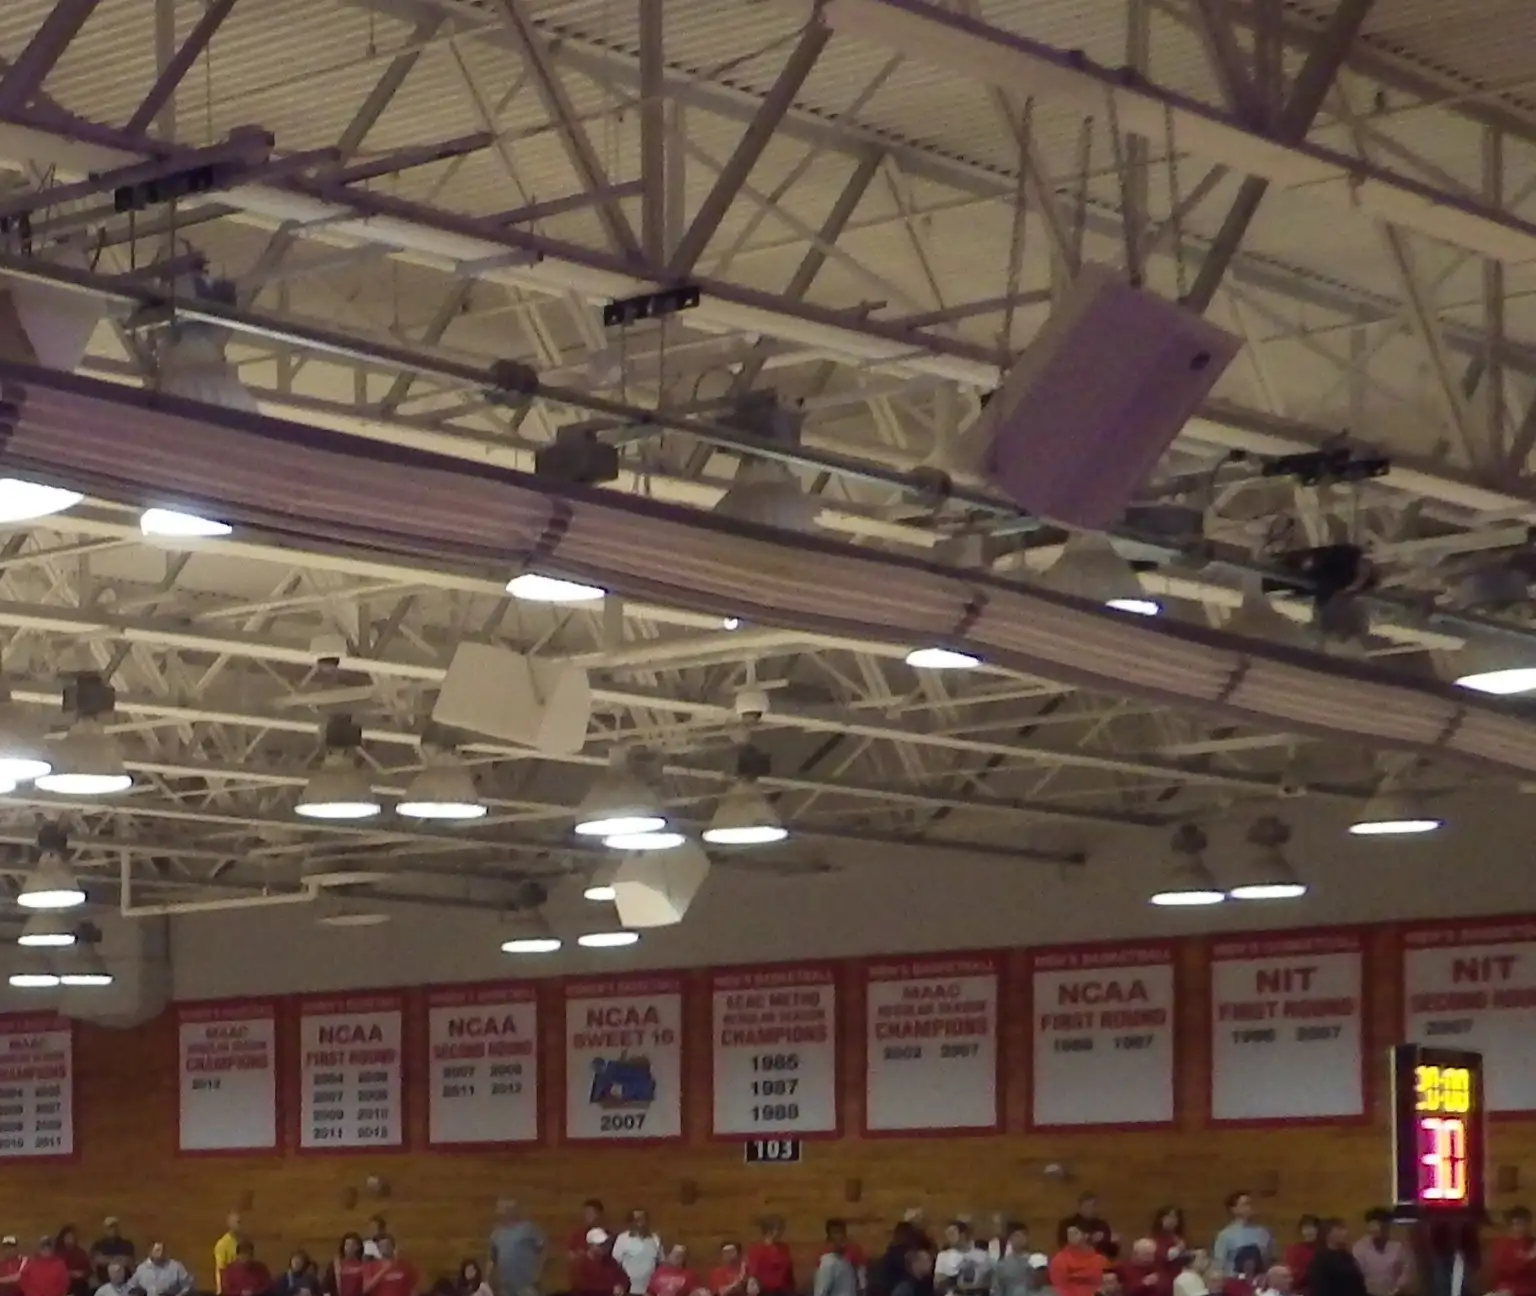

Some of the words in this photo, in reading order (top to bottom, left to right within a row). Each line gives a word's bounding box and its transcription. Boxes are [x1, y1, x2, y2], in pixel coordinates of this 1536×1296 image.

[1451, 955, 1520, 984] NIT
[1256, 966, 1318, 994] NIT
[903, 984, 961, 999] MAAC
[1058, 980, 1149, 1005] NCAA
[448, 1015, 516, 1037] NCAA
[587, 1005, 660, 1027] NCAA
[1041, 1012, 1093, 1031] FIRST
[319, 1024, 383, 1044] NCAA
[574, 1029, 644, 1048] SWEET
[721, 1025, 828, 1046] CHAMPIONS
[875, 1018, 988, 1040] CHAMPIONS
[306, 1051, 344, 1068] FIRST
[751, 1078, 799, 1097] 1987
[600, 1114, 646, 1132] 2007
[754, 1140, 792, 1160] 103
[1421, 1117, 1465, 1199] 30
